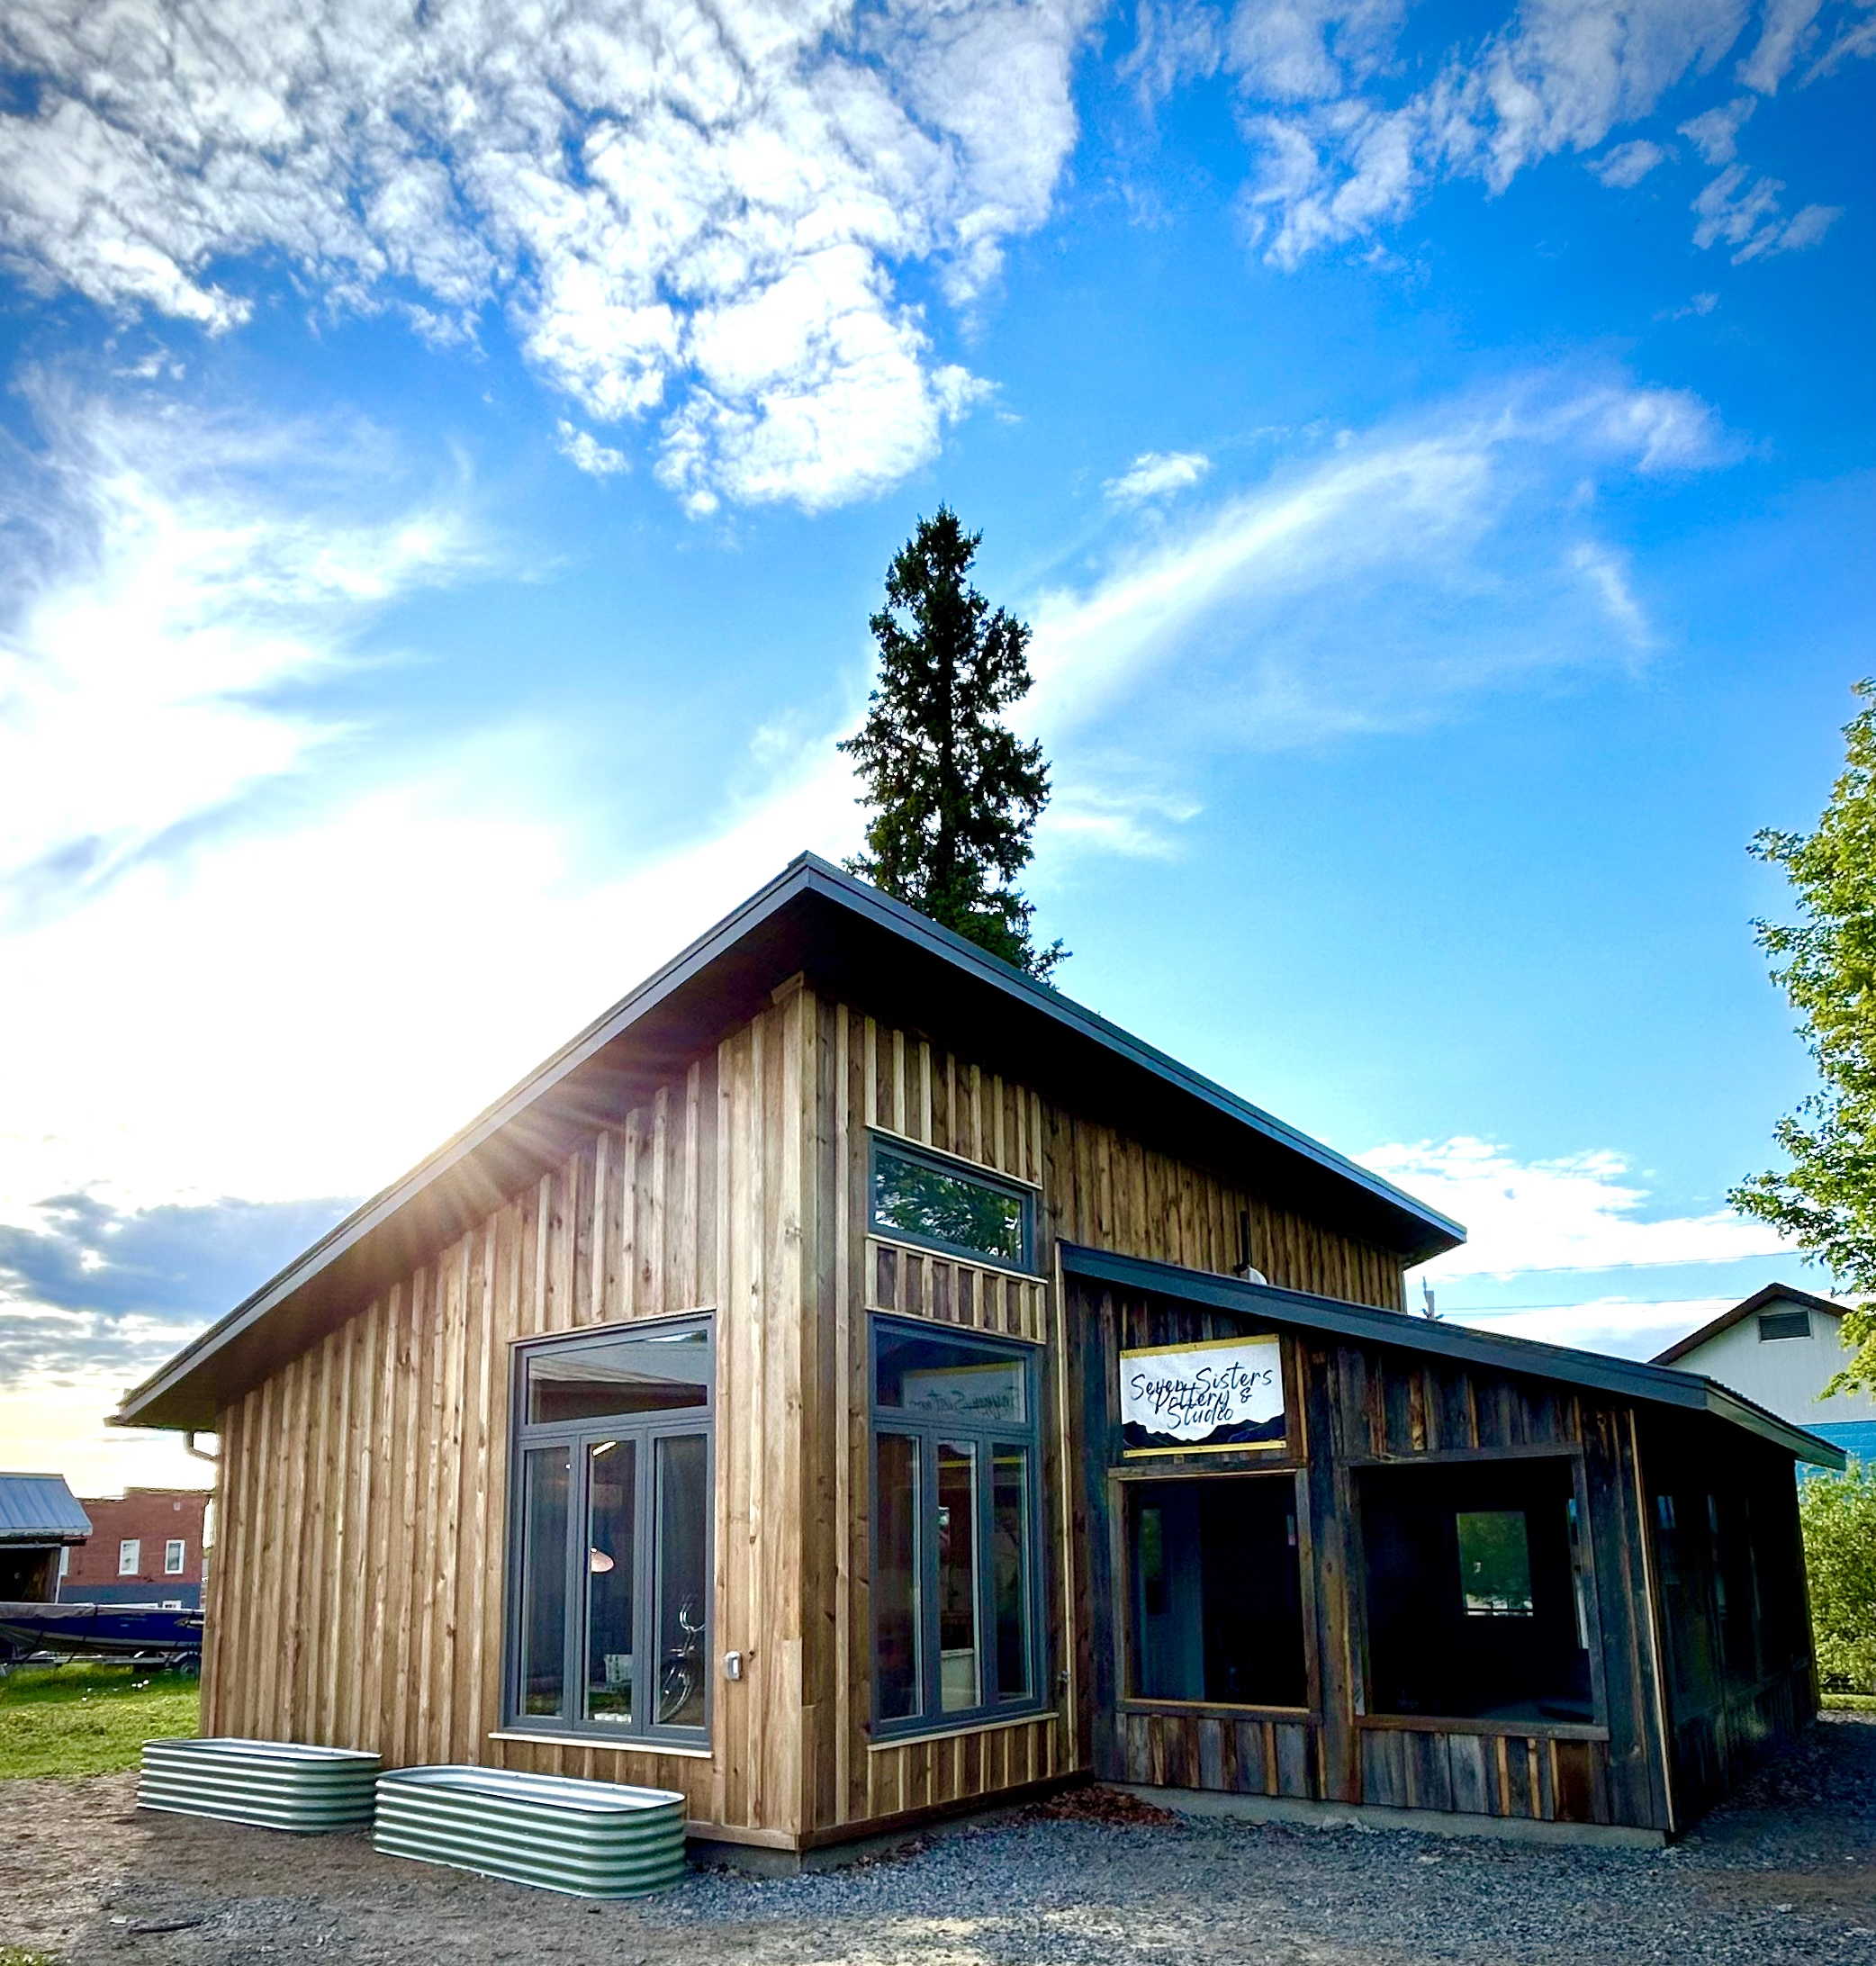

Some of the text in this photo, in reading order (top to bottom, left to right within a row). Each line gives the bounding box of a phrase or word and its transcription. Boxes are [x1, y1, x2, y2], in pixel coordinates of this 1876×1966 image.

[1130, 1361, 1273, 1401] Seven Sisters
[1148, 1381, 1252, 1415] Pottery &
[1167, 1402, 1234, 1430] Studio
